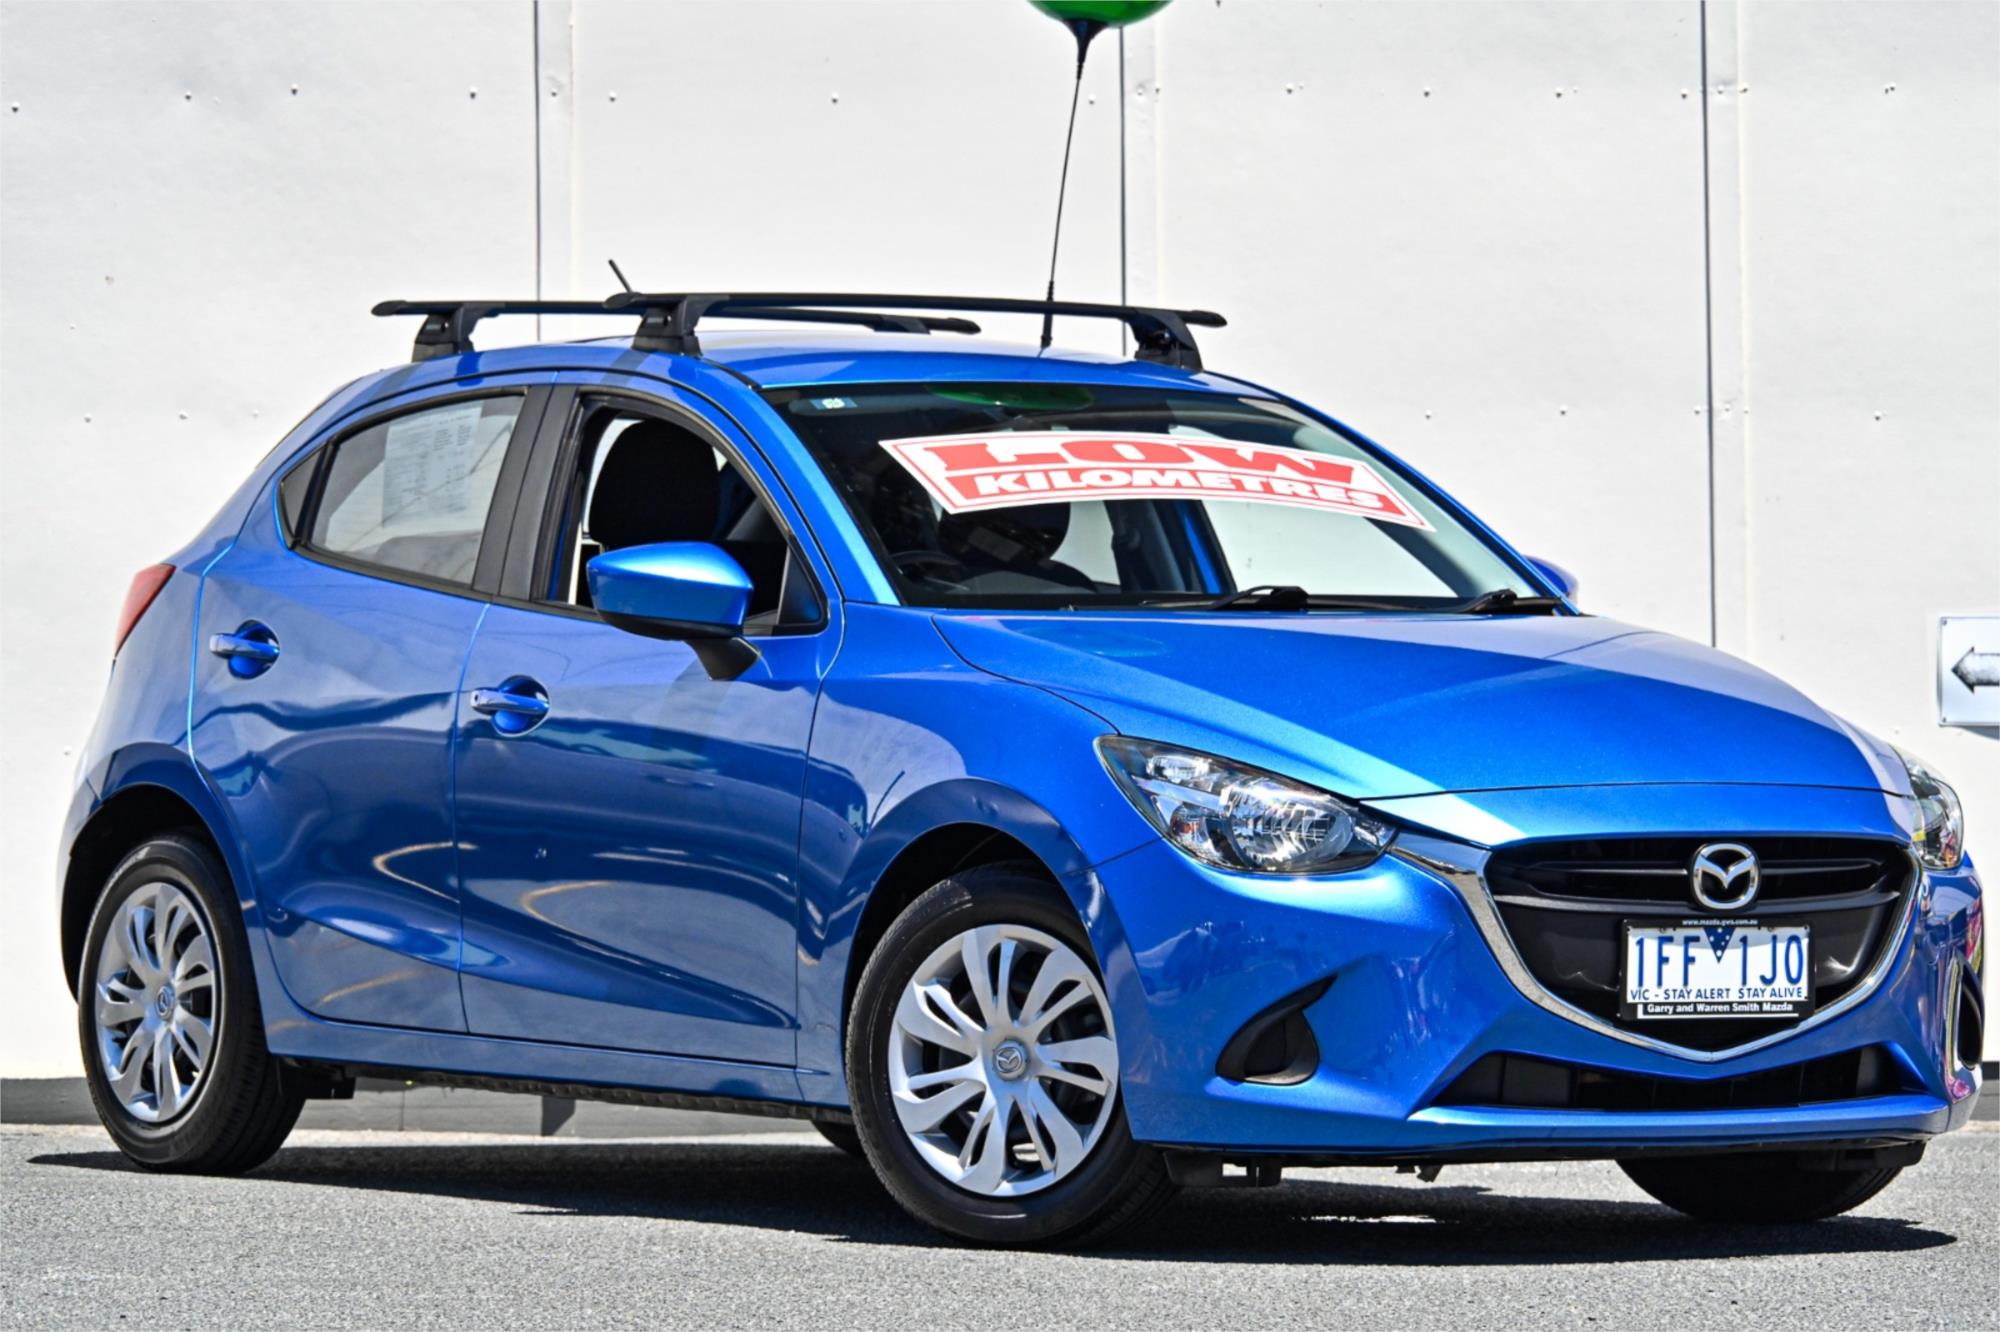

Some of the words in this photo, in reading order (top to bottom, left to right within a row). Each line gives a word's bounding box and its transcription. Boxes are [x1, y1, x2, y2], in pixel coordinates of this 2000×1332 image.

[923, 440, 1354, 484] LOW
[974, 469, 1384, 509] KILOMETRES
[1636, 935, 1700, 988] 1FF
[1630, 988, 1650, 1000] VIC
[1663, 988, 1692, 1000] STAY
[1695, 987, 1730, 999] ALERT
[1738, 987, 1766, 999] STAY
[1769, 986, 1802, 998] ALIVE
[1647, 1003, 1674, 1015] Garry
[1676, 1003, 1694, 1012] and
[1696, 1003, 1730, 1012] Warren
[1732, 1002, 1760, 1012] Smith
[1762, 1001, 1794, 1011] Mazda
